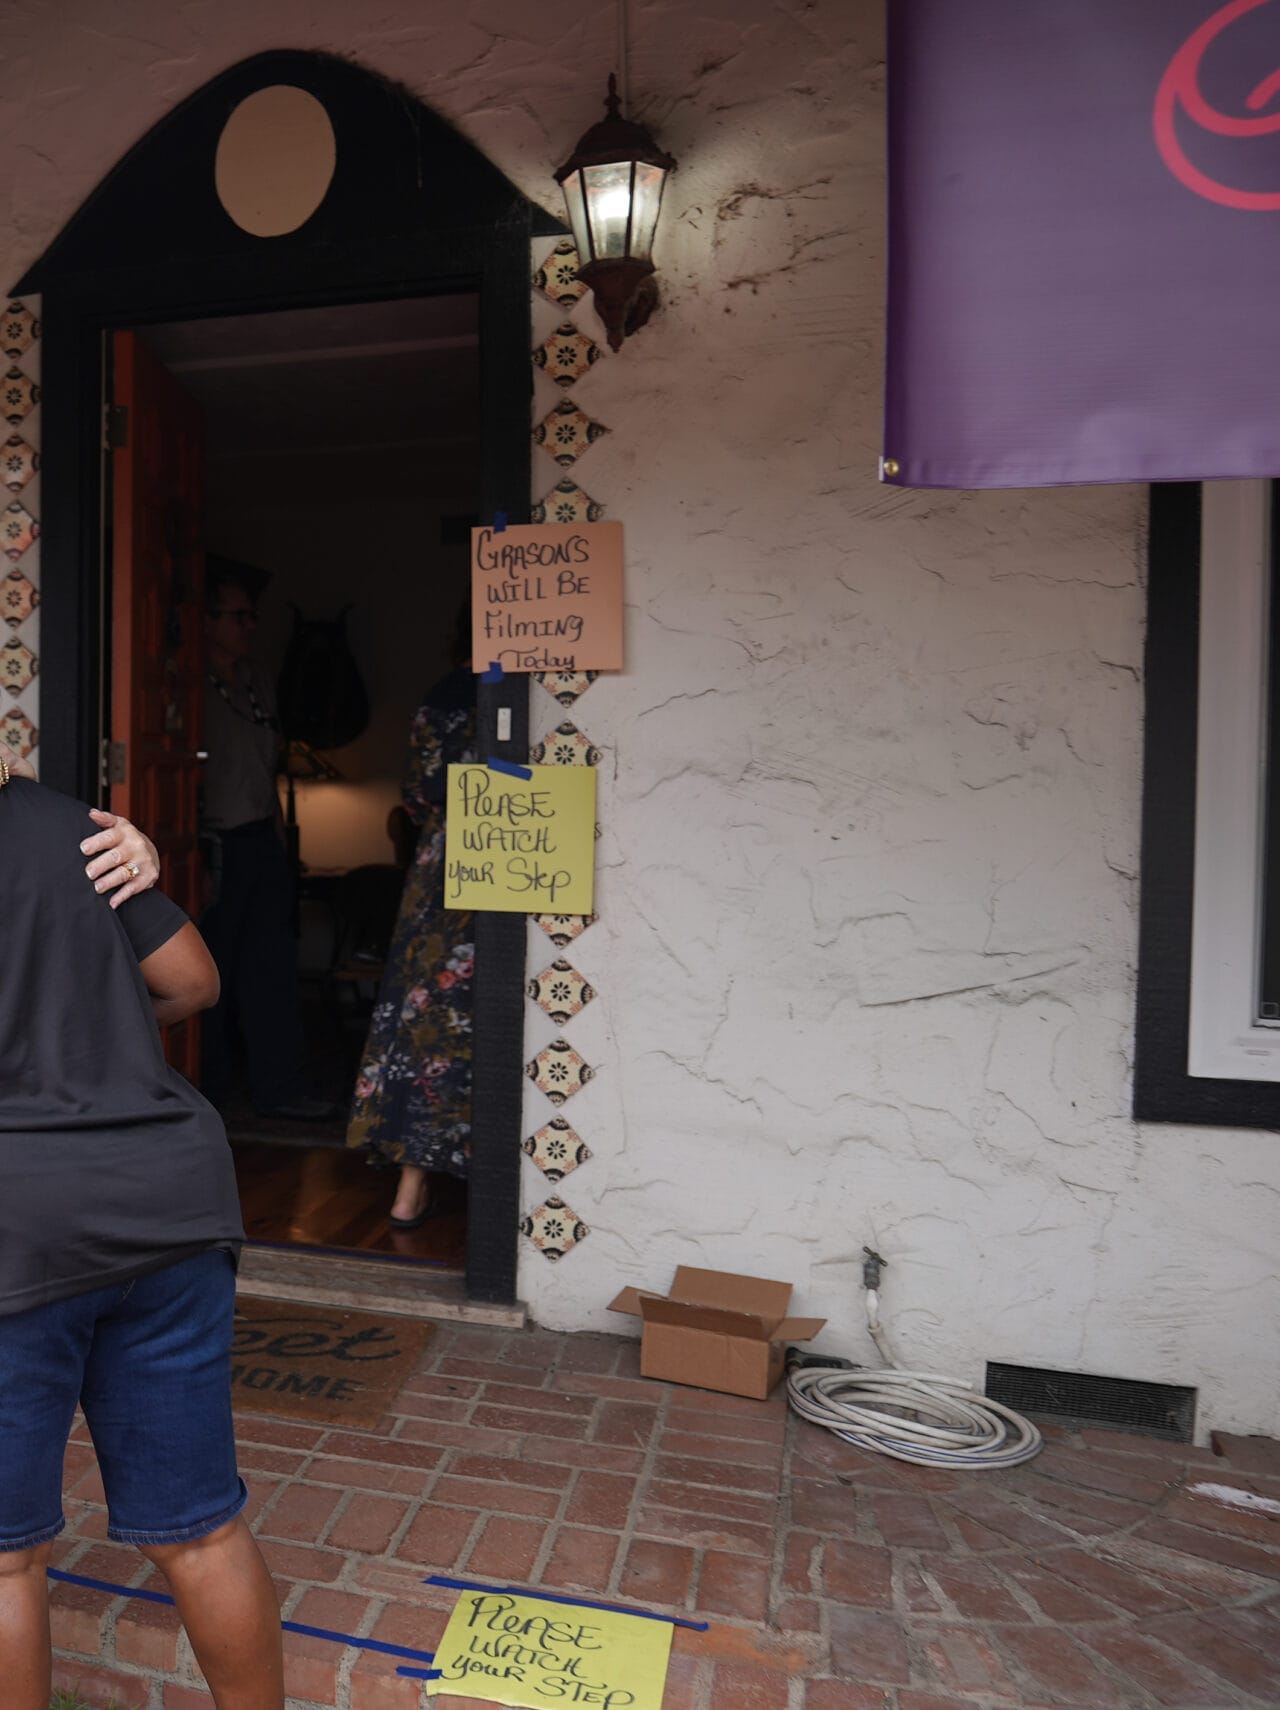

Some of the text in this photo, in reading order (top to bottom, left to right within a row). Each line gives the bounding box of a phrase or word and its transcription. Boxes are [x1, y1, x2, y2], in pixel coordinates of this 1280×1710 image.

[477, 529, 590, 580] GRASONS
[487, 569, 591, 604] WILL BE
[496, 646, 576, 671] Today
[462, 820, 558, 854] WATCH
[468, 1633, 589, 1680] WATCH
[532, 1675, 636, 1710] STEP
